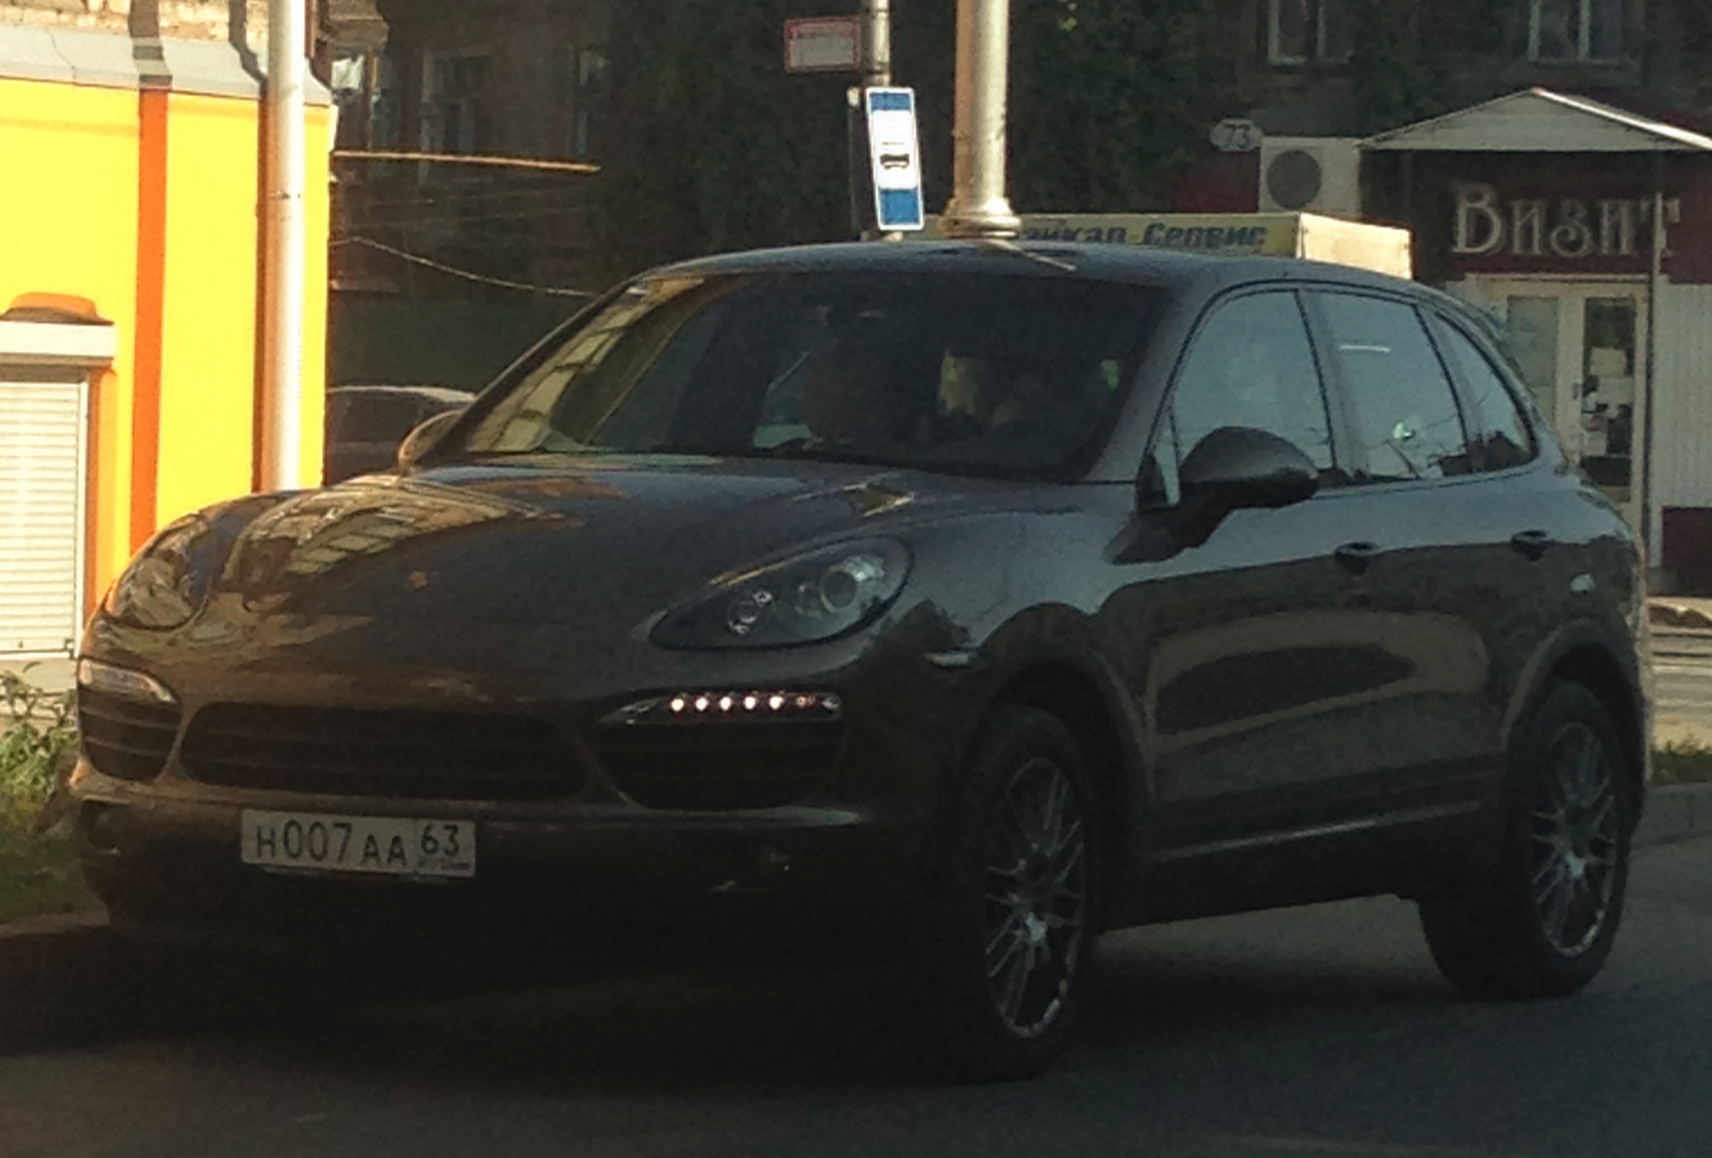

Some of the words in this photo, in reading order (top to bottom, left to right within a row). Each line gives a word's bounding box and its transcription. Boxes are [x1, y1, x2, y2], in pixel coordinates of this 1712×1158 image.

[1224, 124, 1251, 149] 73
[1453, 181, 1681, 257] Визит
[420, 824, 459, 857] 63
